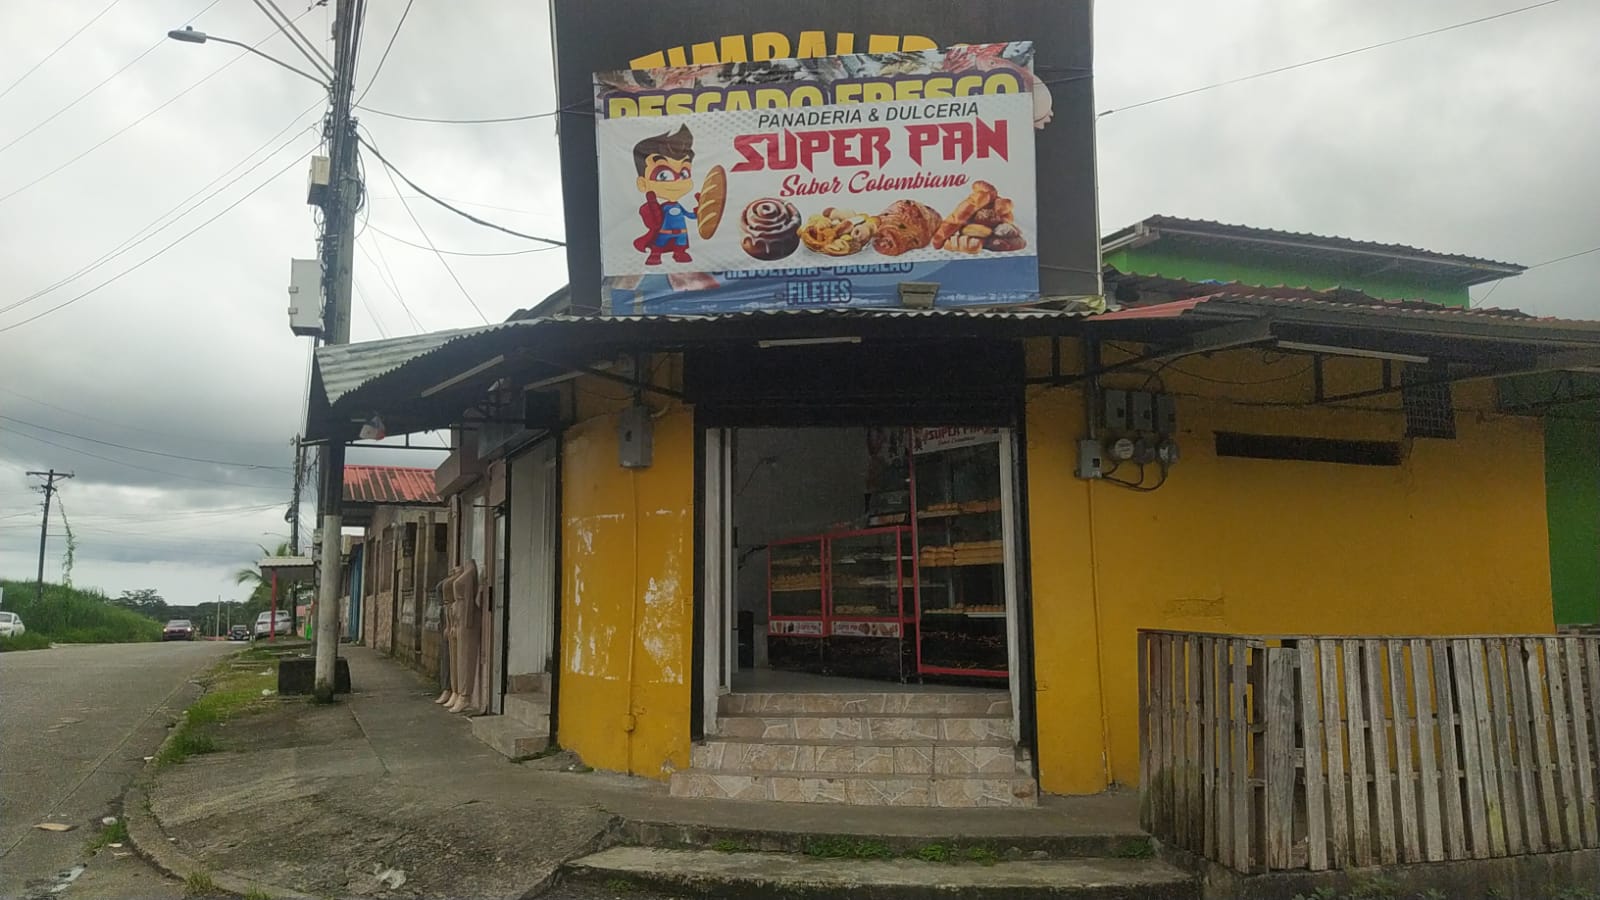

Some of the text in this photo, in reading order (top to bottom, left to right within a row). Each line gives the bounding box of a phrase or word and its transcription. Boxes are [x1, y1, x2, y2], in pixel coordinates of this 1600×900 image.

[758, 101, 979, 129] PANADERIA & DULCERIA
[730, 116, 1009, 173] SUPER PAN
[780, 170, 970, 197] Sabor Colombiano
[787, 281, 851, 304] FILETES
